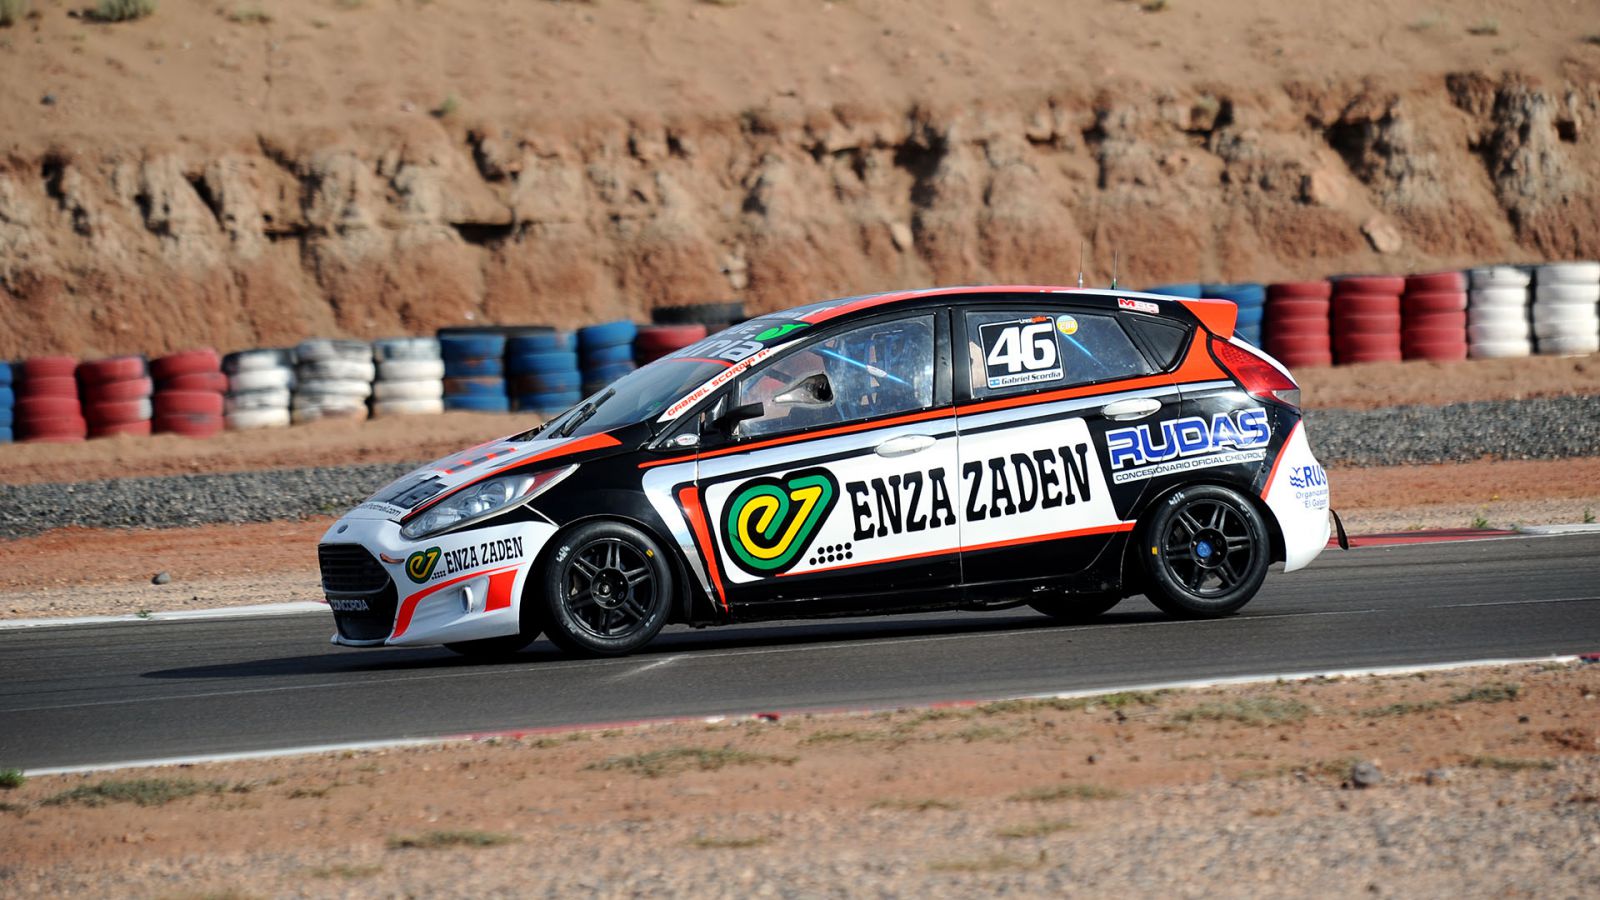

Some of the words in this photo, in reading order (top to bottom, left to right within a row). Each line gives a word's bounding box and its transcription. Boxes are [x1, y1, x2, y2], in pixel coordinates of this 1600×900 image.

[988, 323, 1057, 373] 46
[667, 388, 710, 417] GABRIEL
[712, 357, 756, 387] SCORDIA
[1001, 374, 1031, 385] Gabriel
[1031, 371, 1061, 381] Scordia
[1106, 408, 1271, 469] RUDAS
[846, 466, 956, 541] ENZA
[962, 443, 1092, 522] ZADEN
[1115, 462, 1191, 482] CONCESIONARIO
[1191, 458, 1225, 469] OFICIAL
[443, 546, 479, 574] ENZA
[480, 536, 524, 565] ZADEN
